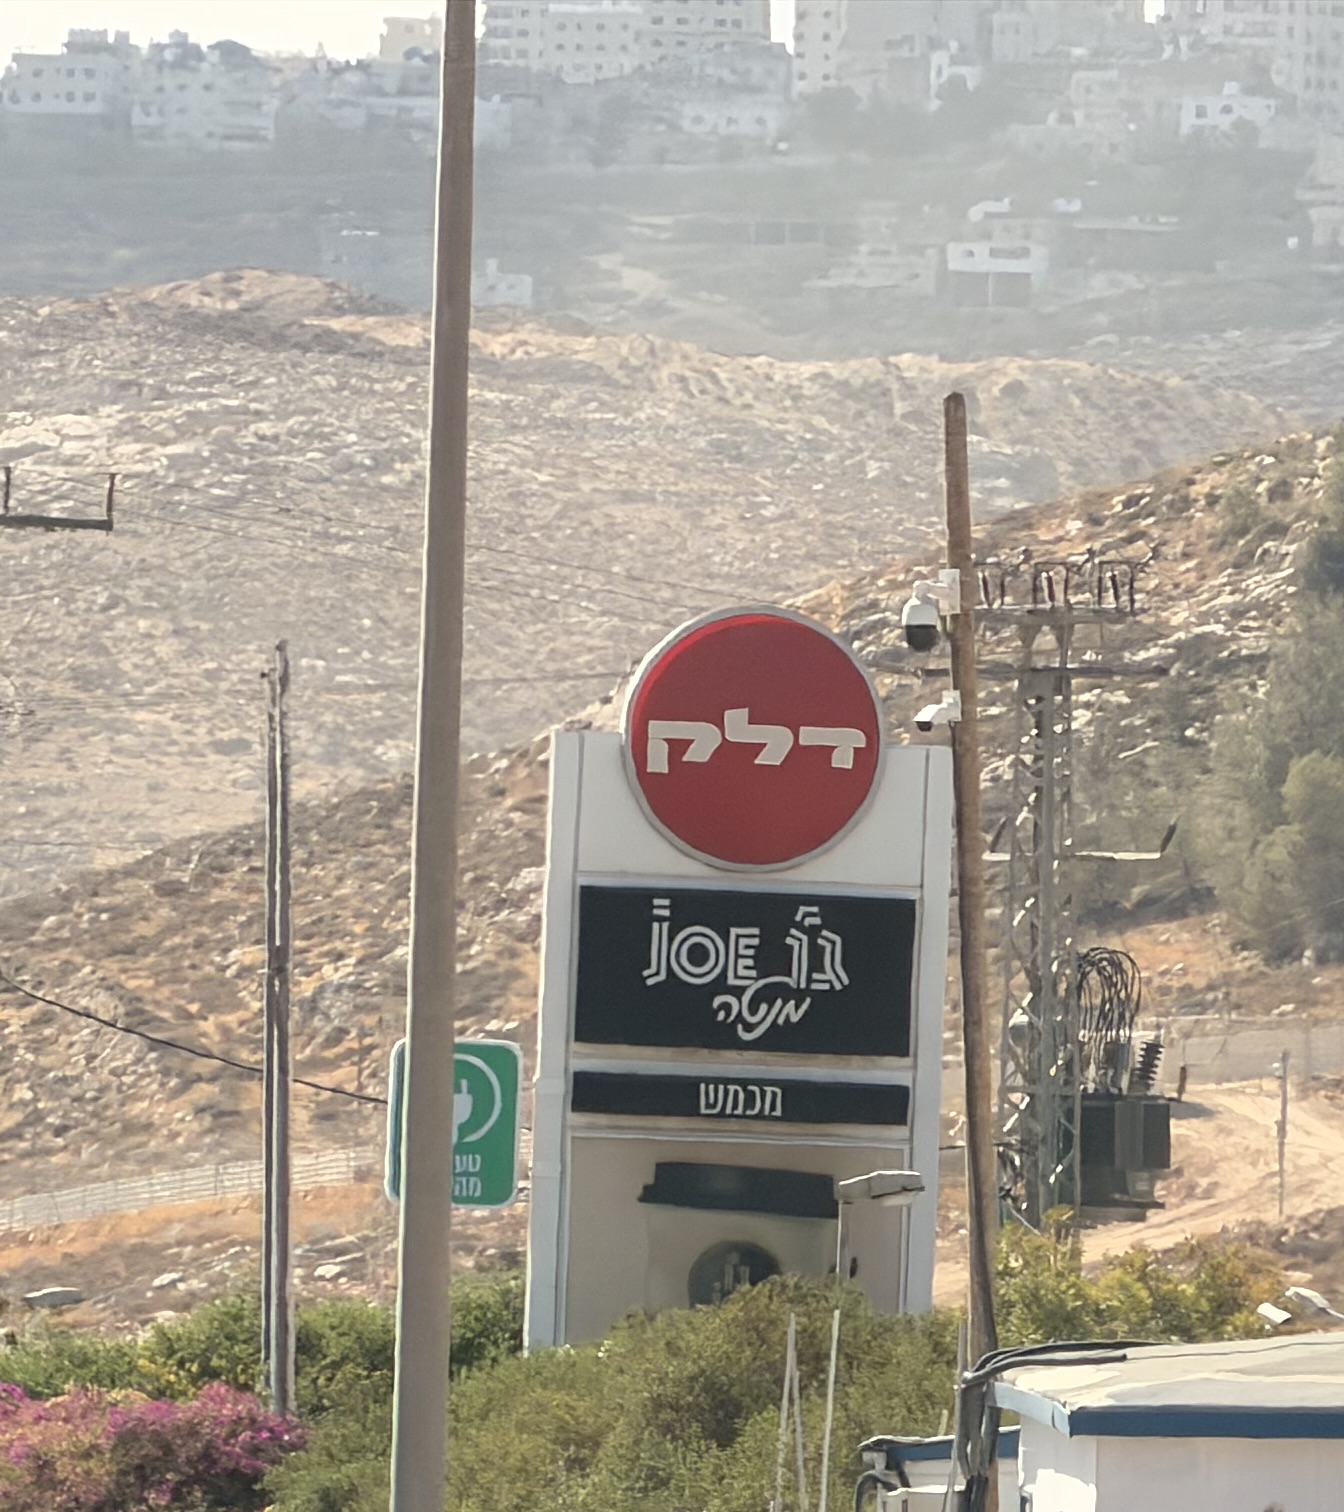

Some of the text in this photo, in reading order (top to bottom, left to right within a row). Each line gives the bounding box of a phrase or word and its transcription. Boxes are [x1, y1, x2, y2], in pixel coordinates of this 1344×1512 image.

[646, 708, 867, 774] דלק
[713, 976, 812, 1041] מנטה
[700, 1083, 782, 1116] מכמש
